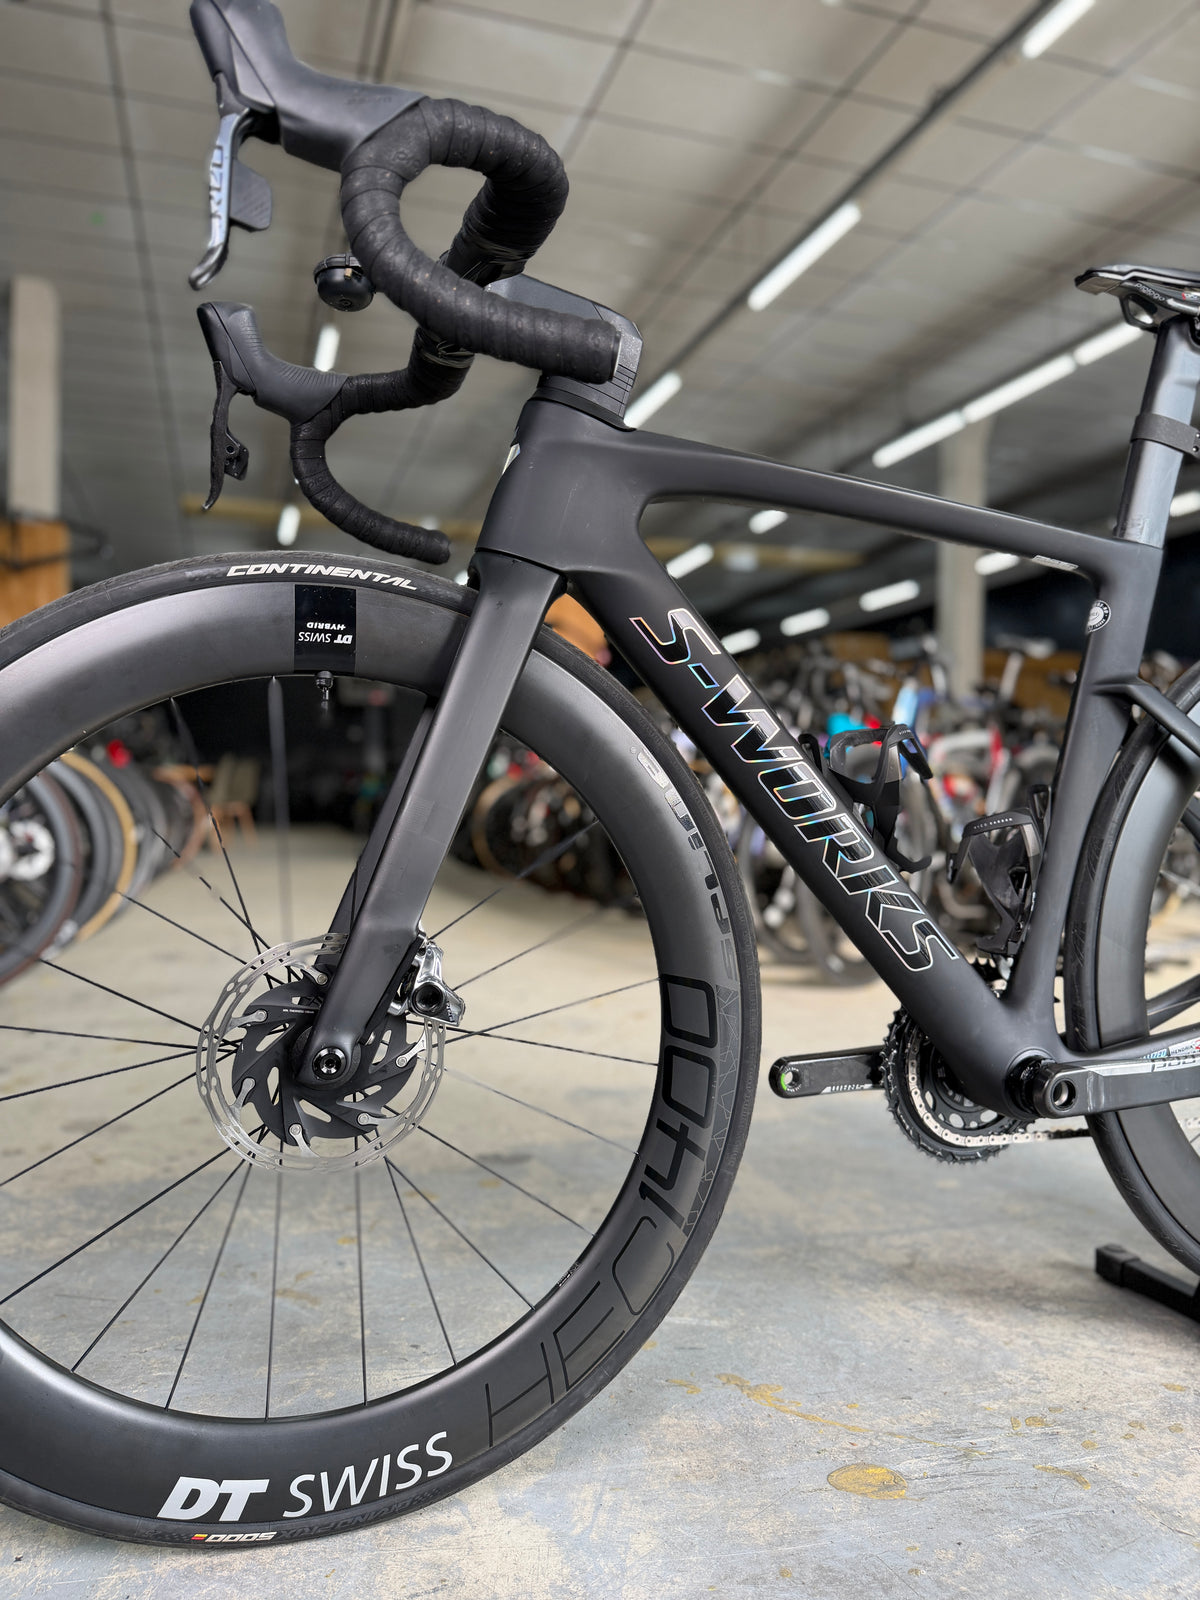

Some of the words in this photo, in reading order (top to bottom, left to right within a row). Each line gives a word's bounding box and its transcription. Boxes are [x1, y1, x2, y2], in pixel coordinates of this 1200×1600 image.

[226, 563, 417, 591] CONTINENTAL
[306, 621, 346, 631] HYBRID
[298, 631, 332, 644] SWISS
[334, 633, 353, 645] DT
[629, 608, 959, 972] S-WORKS
[484, 1216, 675, 1448] HEC
[638, 973, 718, 1237] 1400
[156, 1475, 270, 1522] DT
[282, 1431, 453, 1518] SWISS
[205, 1531, 277, 1543] 5000
